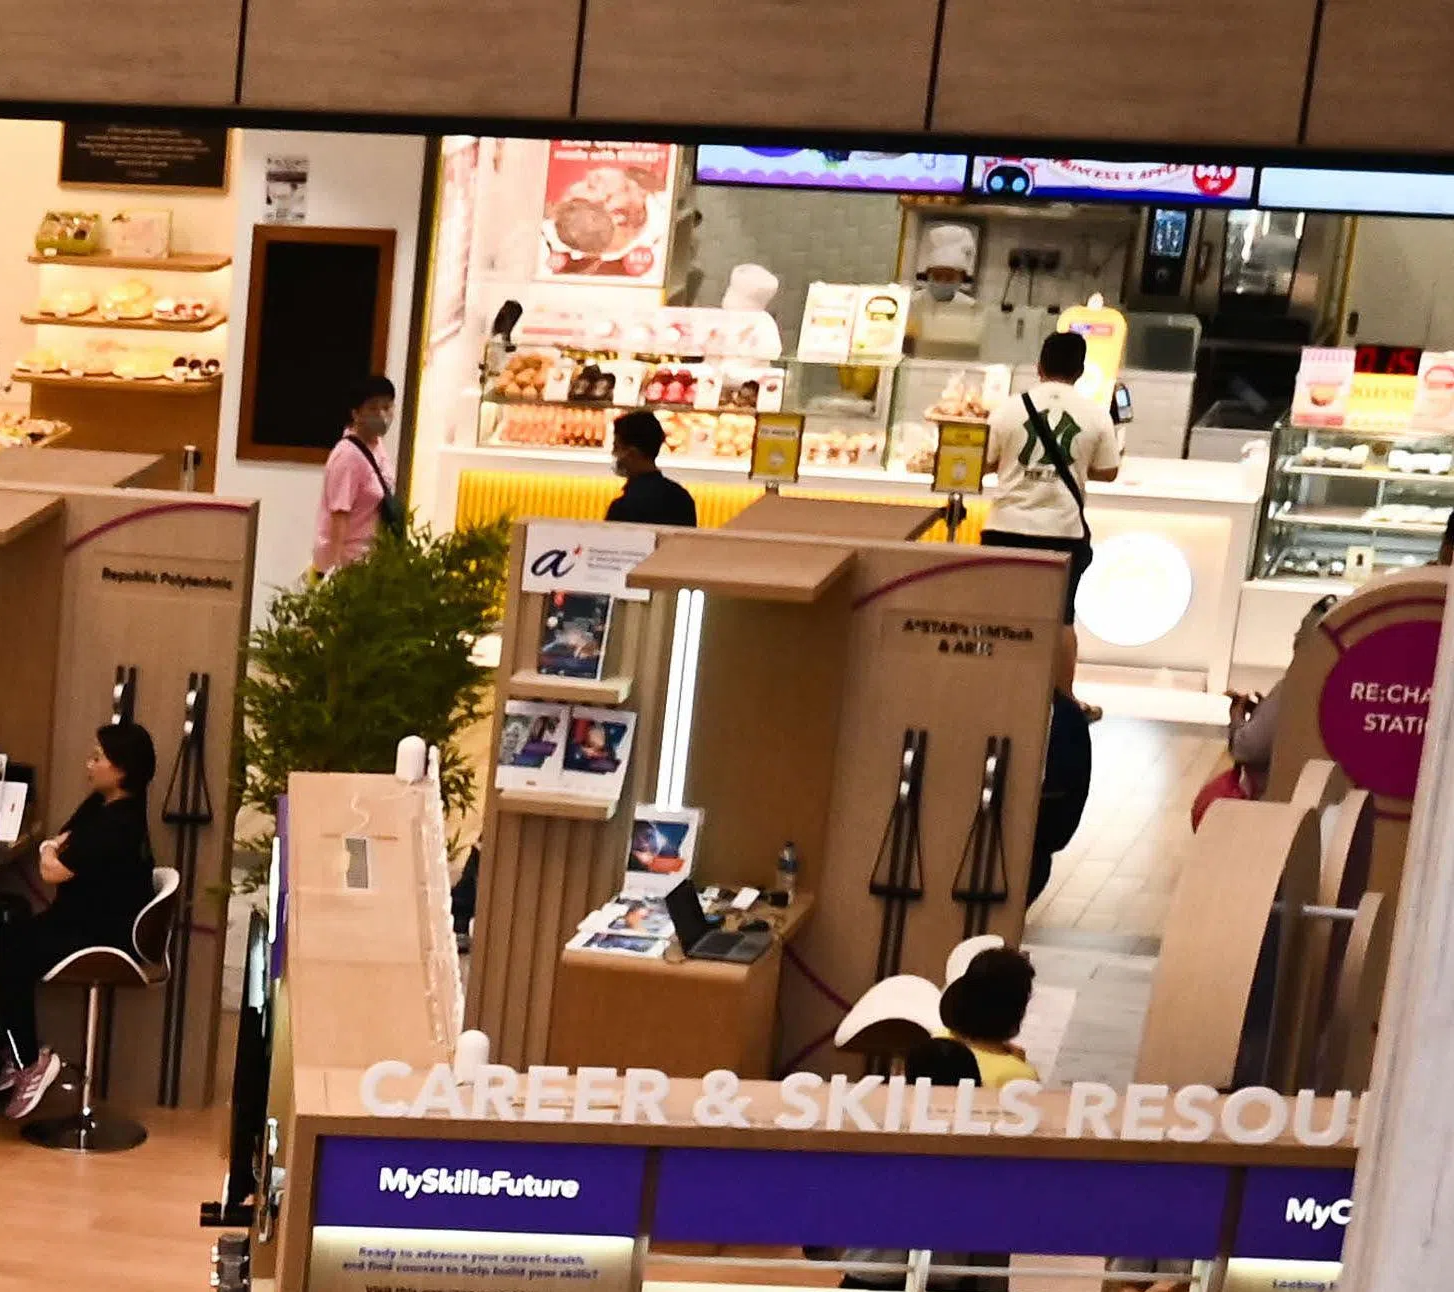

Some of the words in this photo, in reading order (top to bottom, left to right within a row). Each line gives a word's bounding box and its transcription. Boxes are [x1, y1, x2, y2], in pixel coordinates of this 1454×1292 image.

[1350, 682, 1430, 706] RE:CHA
[1363, 712, 1426, 736] STATI
[359, 1059, 672, 1124] CAREER
[691, 1069, 752, 1129] &
[773, 1072, 1041, 1139] SKILLS
[1065, 1081, 1366, 1146] RESOU
[379, 1167, 580, 1200] MySkillsFuture
[1285, 1196, 1352, 1229] MyC
